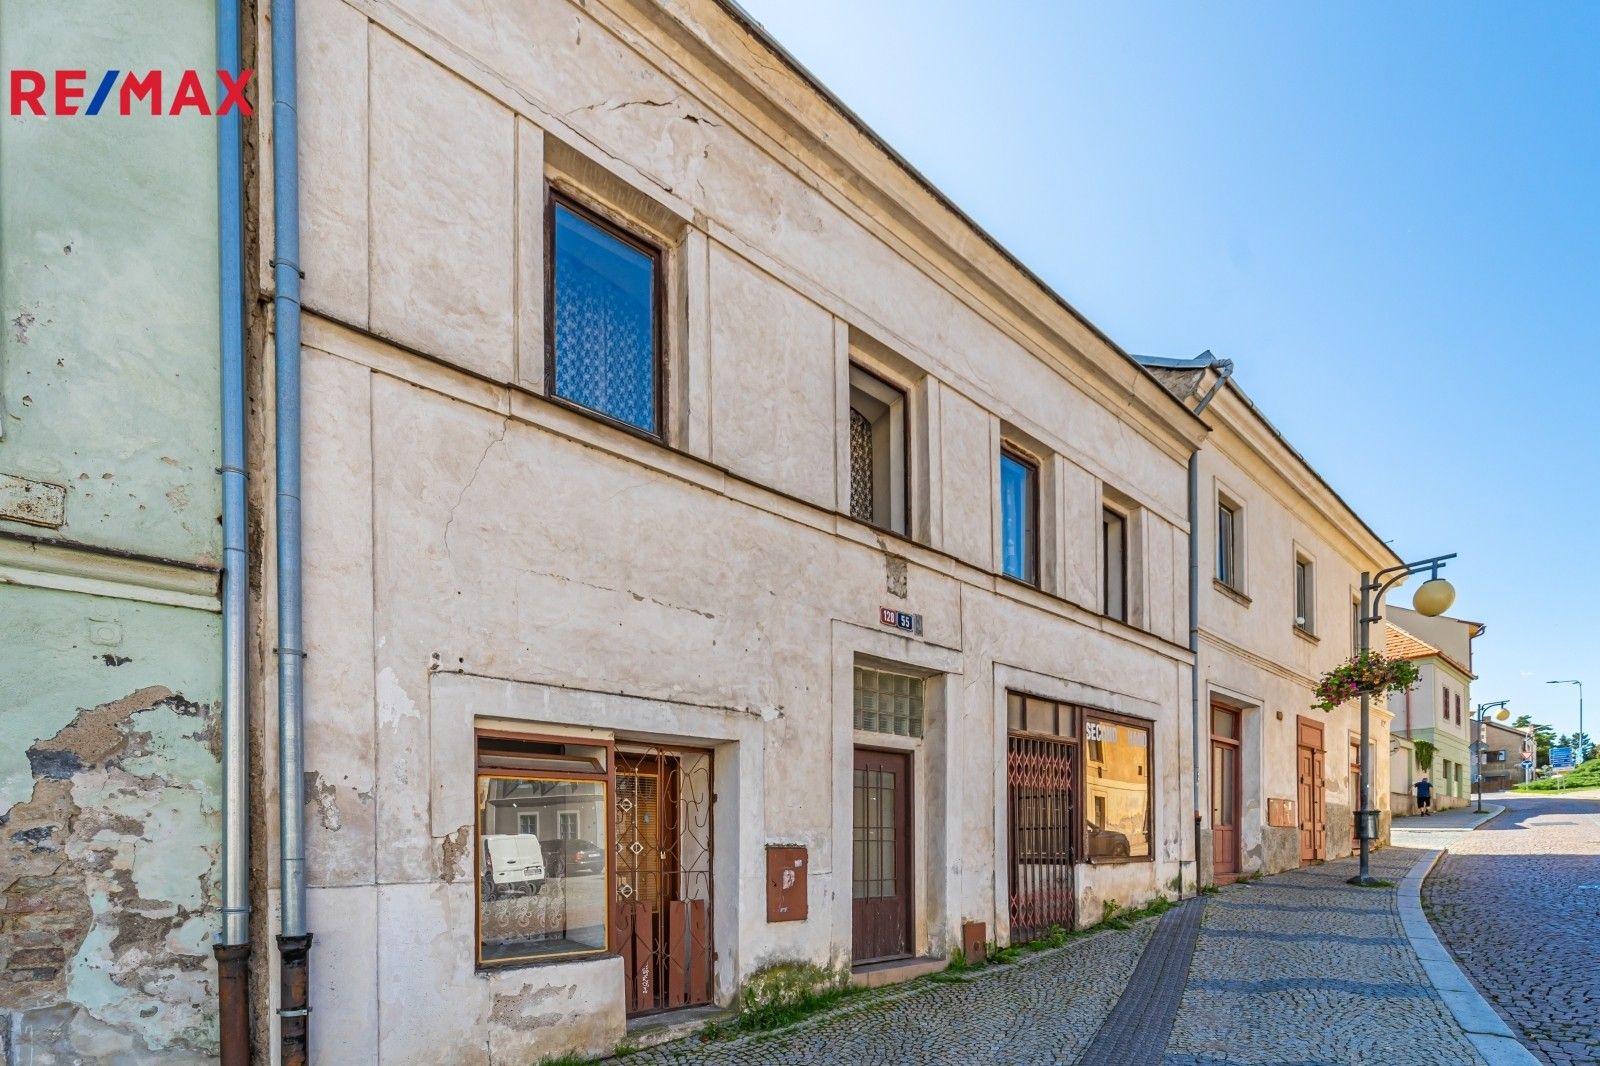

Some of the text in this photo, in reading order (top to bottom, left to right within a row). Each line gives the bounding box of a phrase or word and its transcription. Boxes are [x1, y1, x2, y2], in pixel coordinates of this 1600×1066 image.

[883, 610, 895, 623] 128
[900, 614, 910, 628] 55
[1086, 722, 1117, 743] SEC
